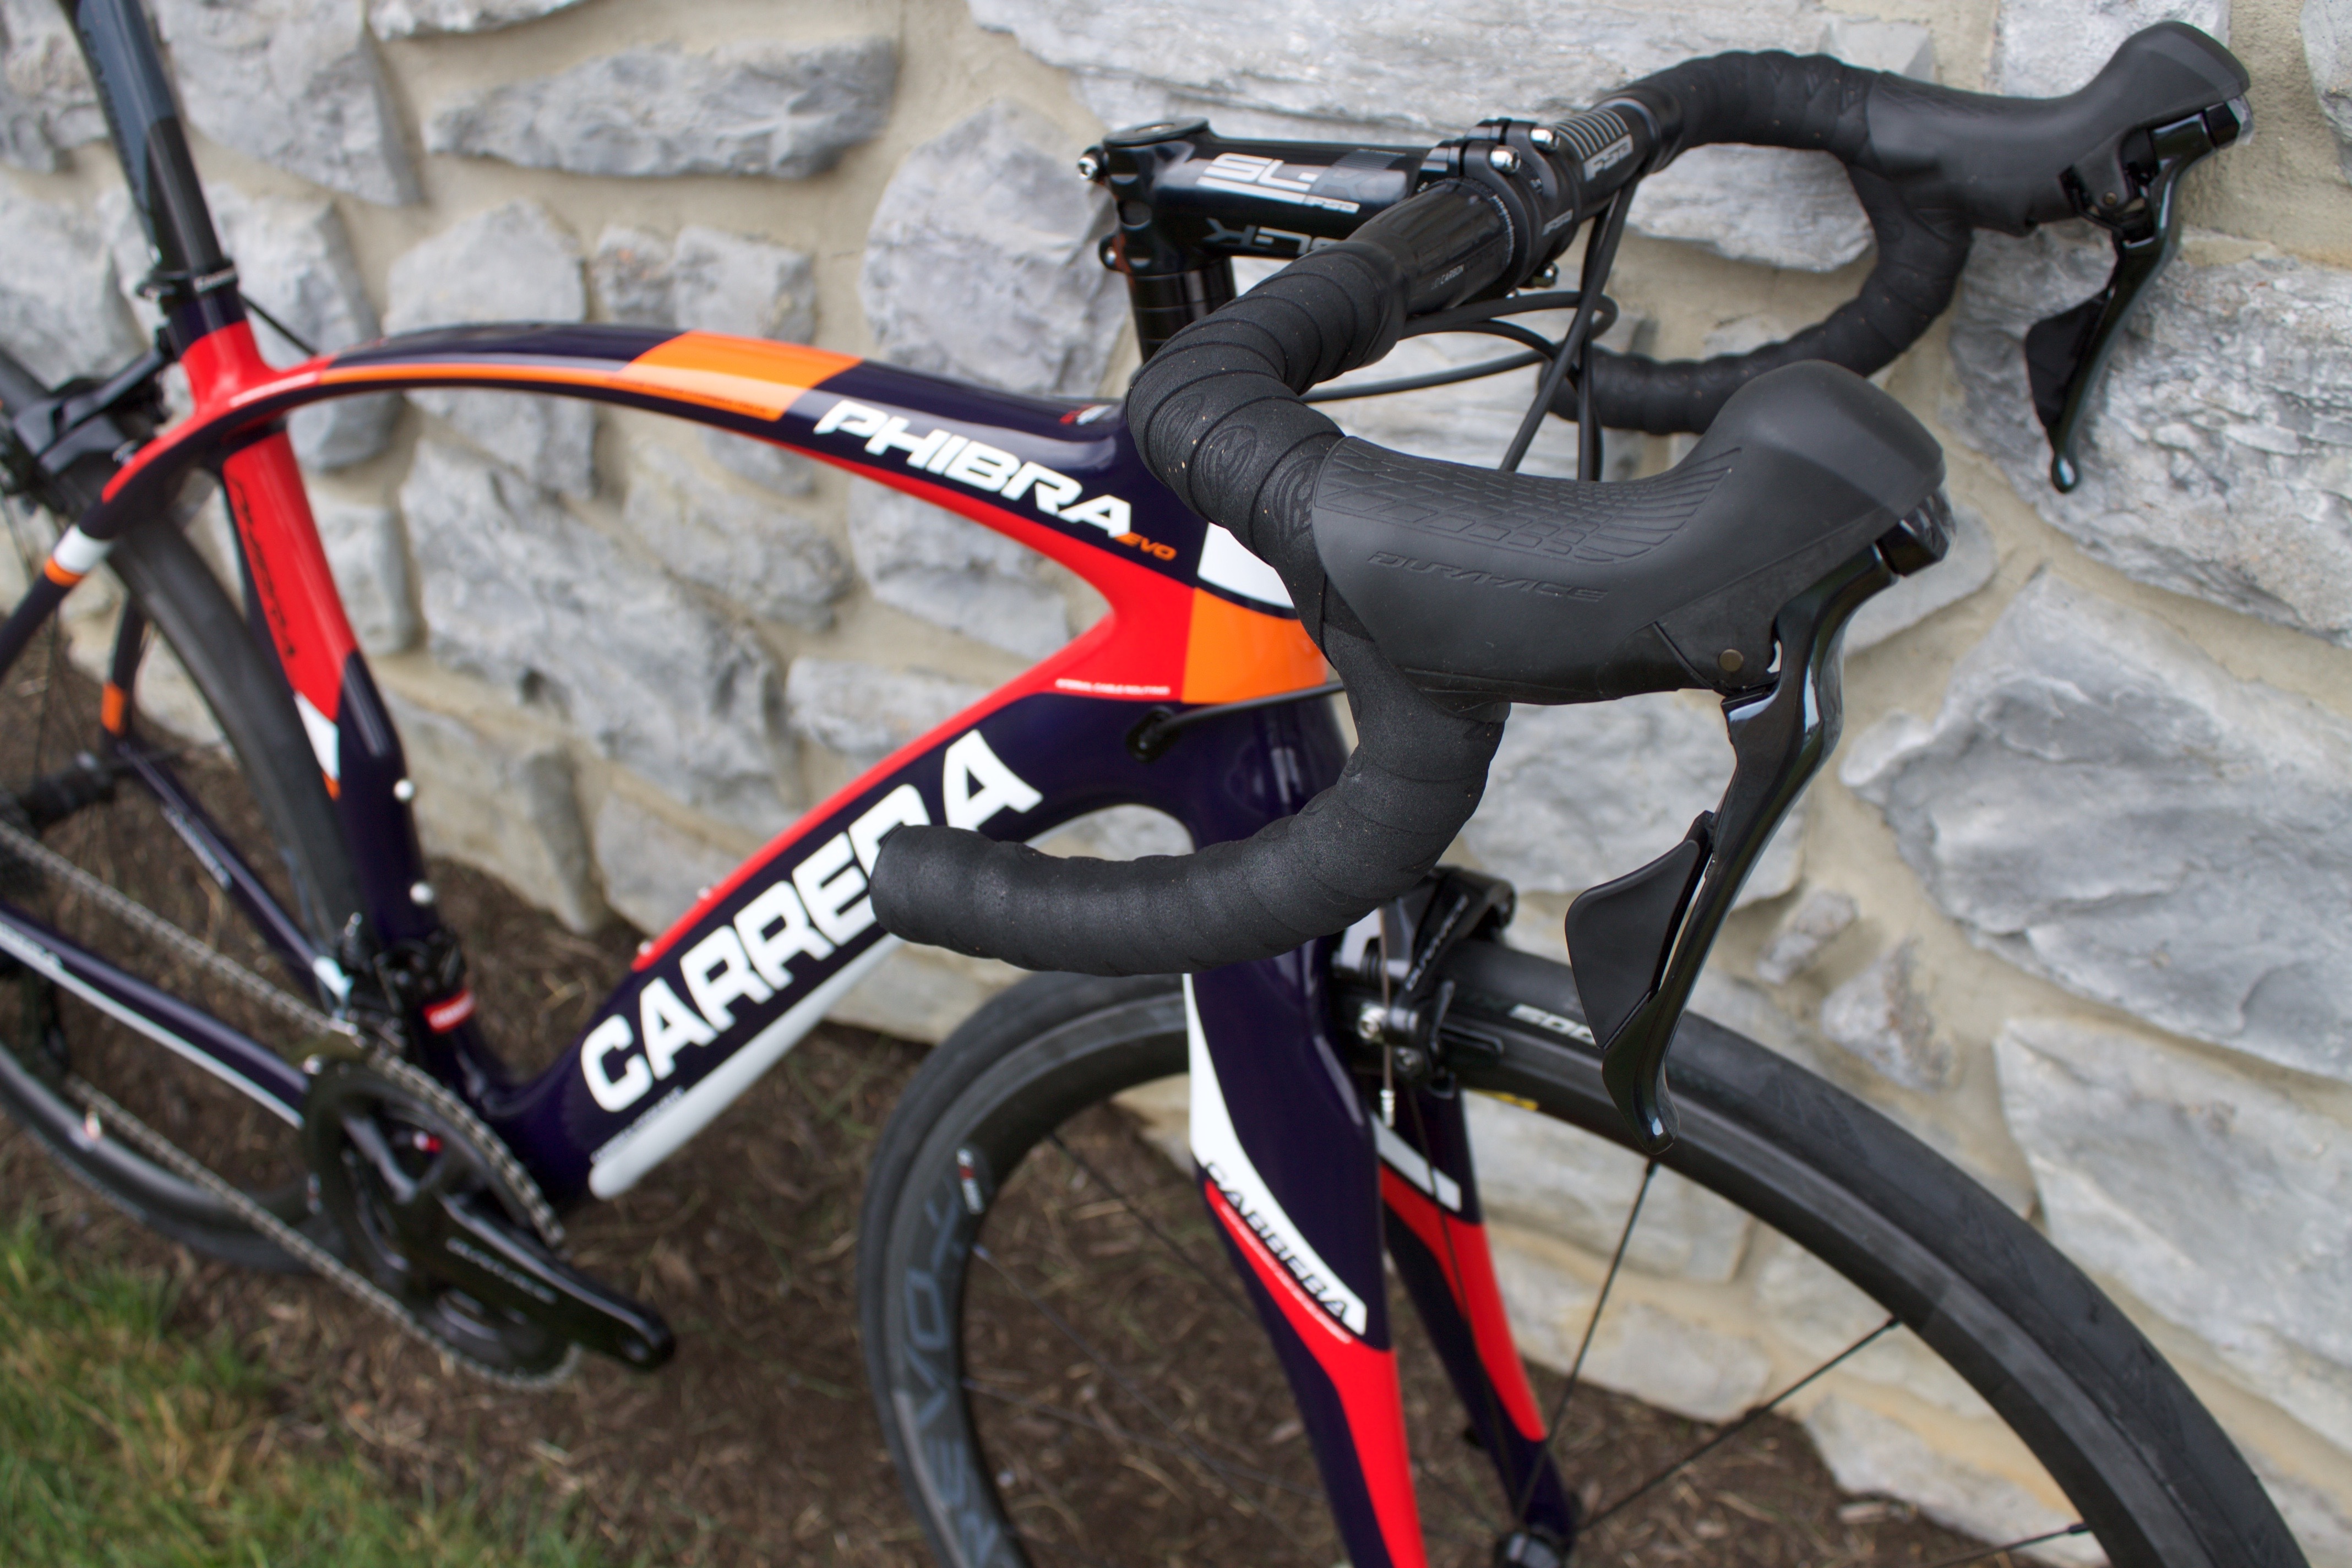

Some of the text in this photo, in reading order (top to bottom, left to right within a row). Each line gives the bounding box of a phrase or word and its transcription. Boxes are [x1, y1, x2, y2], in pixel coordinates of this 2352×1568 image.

[813, 399, 1131, 538] PHIBRA
[1114, 531, 1177, 560] EVO
[1367, 550, 1609, 602] DURA-ACE
